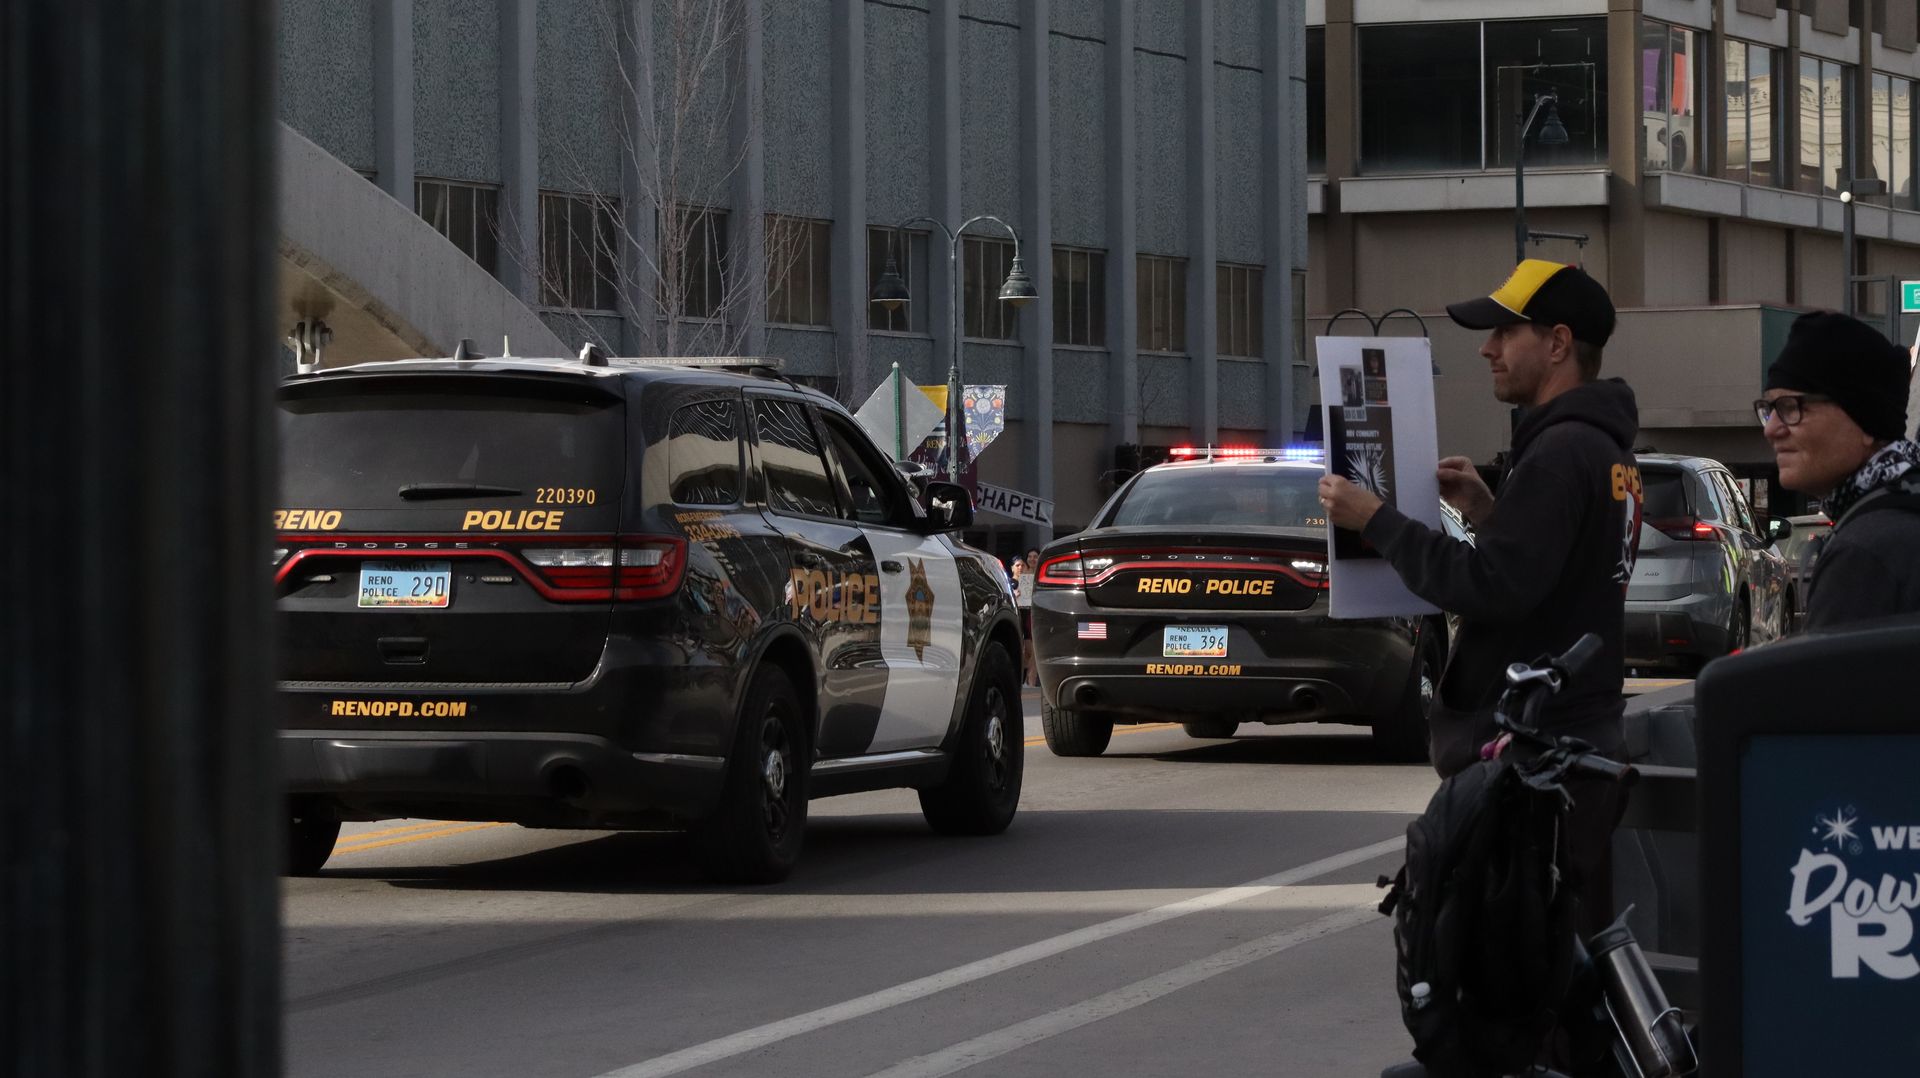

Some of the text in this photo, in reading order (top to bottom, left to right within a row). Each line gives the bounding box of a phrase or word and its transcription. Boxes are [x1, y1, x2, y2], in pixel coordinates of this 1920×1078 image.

[536, 487, 596, 505] 220390
[462, 510, 564, 531] POLICE
[368, 575, 393, 585] RENO
[412, 576, 445, 597] 290
[1137, 577, 1275, 596] RENO POLICE
[362, 587, 398, 597] POLICE
[788, 567, 879, 625] POLICE
[1201, 635, 1224, 650] 396
[1146, 663, 1241, 676] RENOPD.COM
[331, 701, 467, 717] RENOPD.COM
